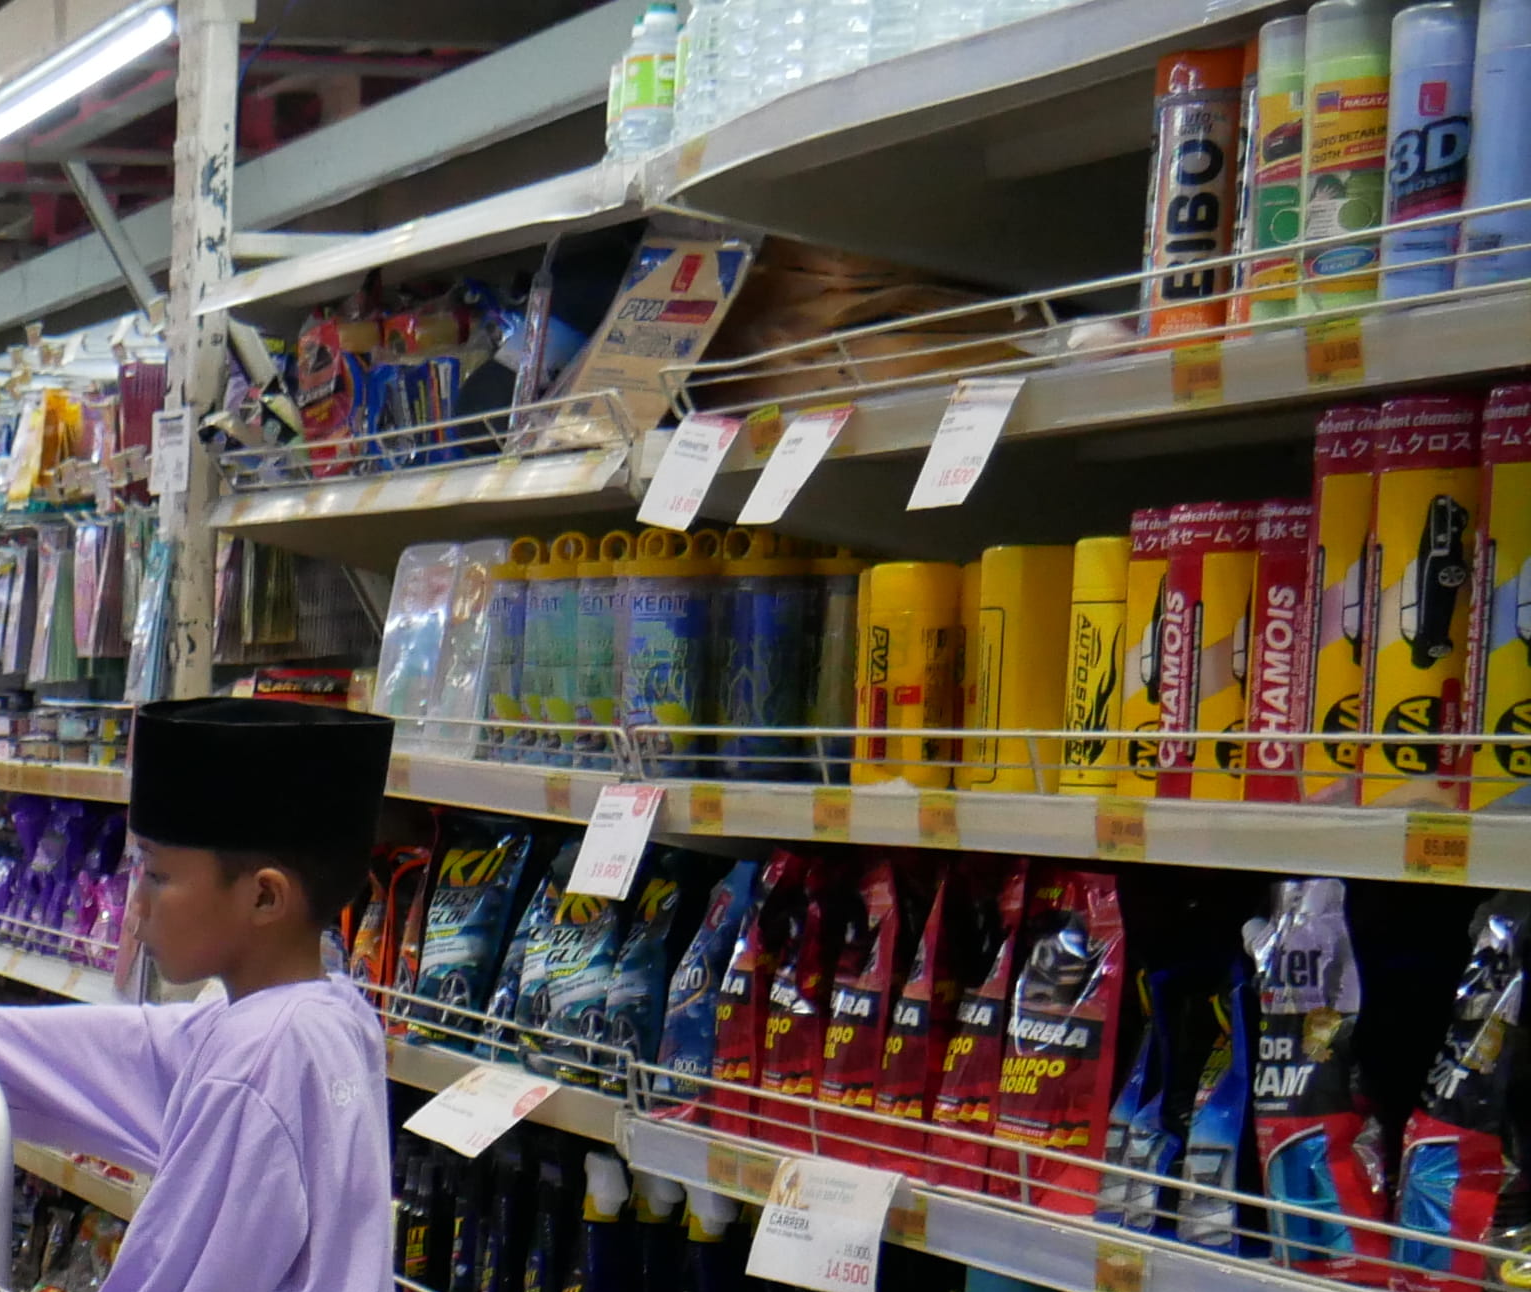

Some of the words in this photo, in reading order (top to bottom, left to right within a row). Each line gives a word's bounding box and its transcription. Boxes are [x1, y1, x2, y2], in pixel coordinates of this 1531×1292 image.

[1339, 125, 1388, 147] DETAILIN
[1391, 118, 1470, 184] 3D
[1161, 138, 1224, 301] EIBO
[1376, 431, 1472, 454] ームクロス
[871, 625, 889, 684] PVA
[1159, 592, 1185, 767] CHAMOIS
[1258, 585, 1295, 768] CHAMOIS
[1396, 698, 1432, 774] PVA
[769, 1211, 811, 1231] CARRERA
[823, 1260, 870, 1286] 14,500
